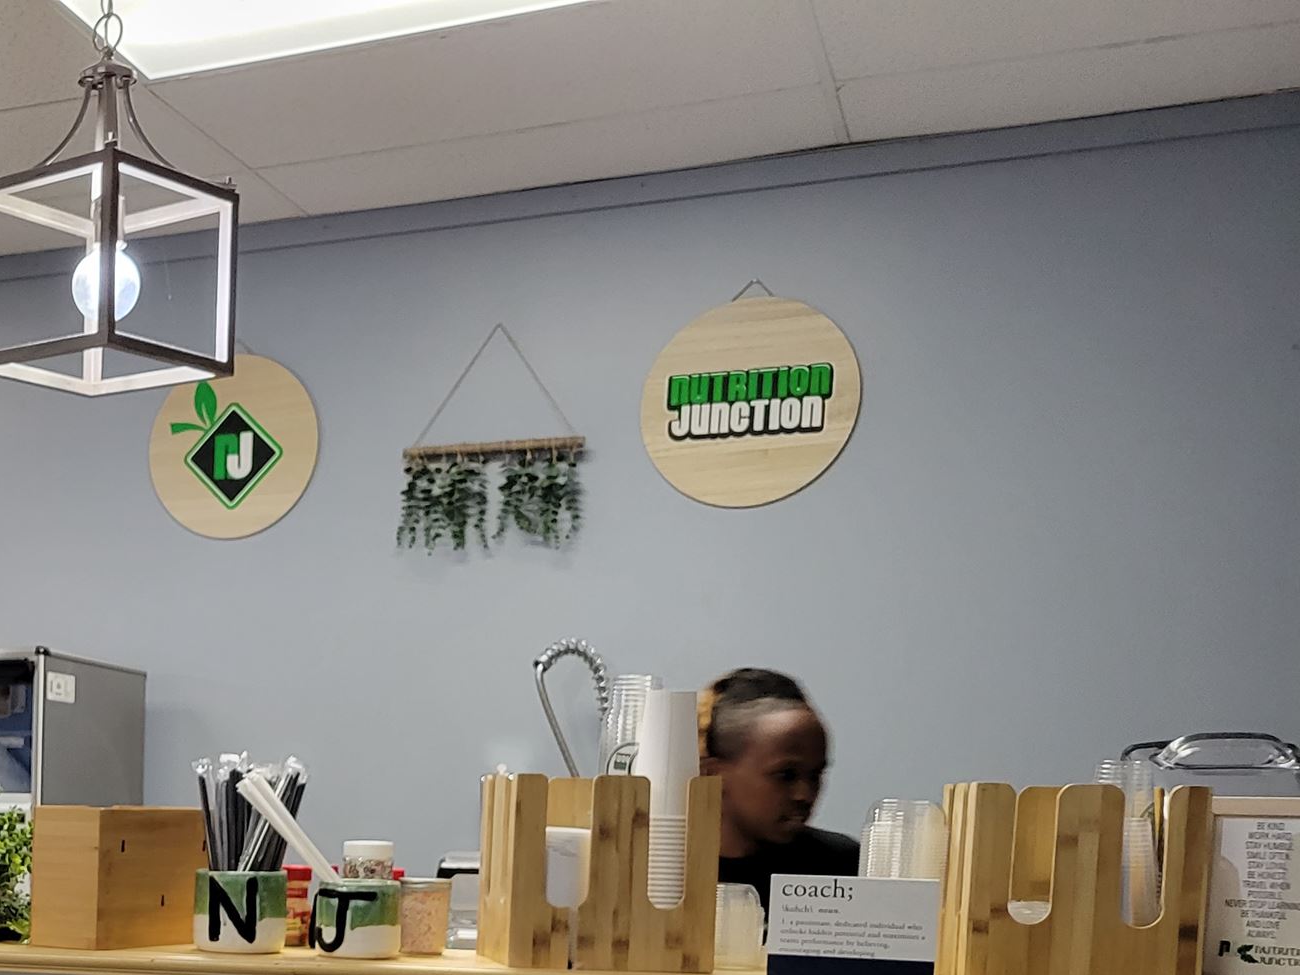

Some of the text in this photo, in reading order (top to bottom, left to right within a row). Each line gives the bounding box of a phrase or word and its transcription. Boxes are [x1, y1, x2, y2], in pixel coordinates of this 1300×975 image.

[668, 362, 834, 409] NUTRITION
[668, 395, 824, 440] JUNCTION
[208, 874, 258, 944] N
[782, 878, 853, 901] coach;
